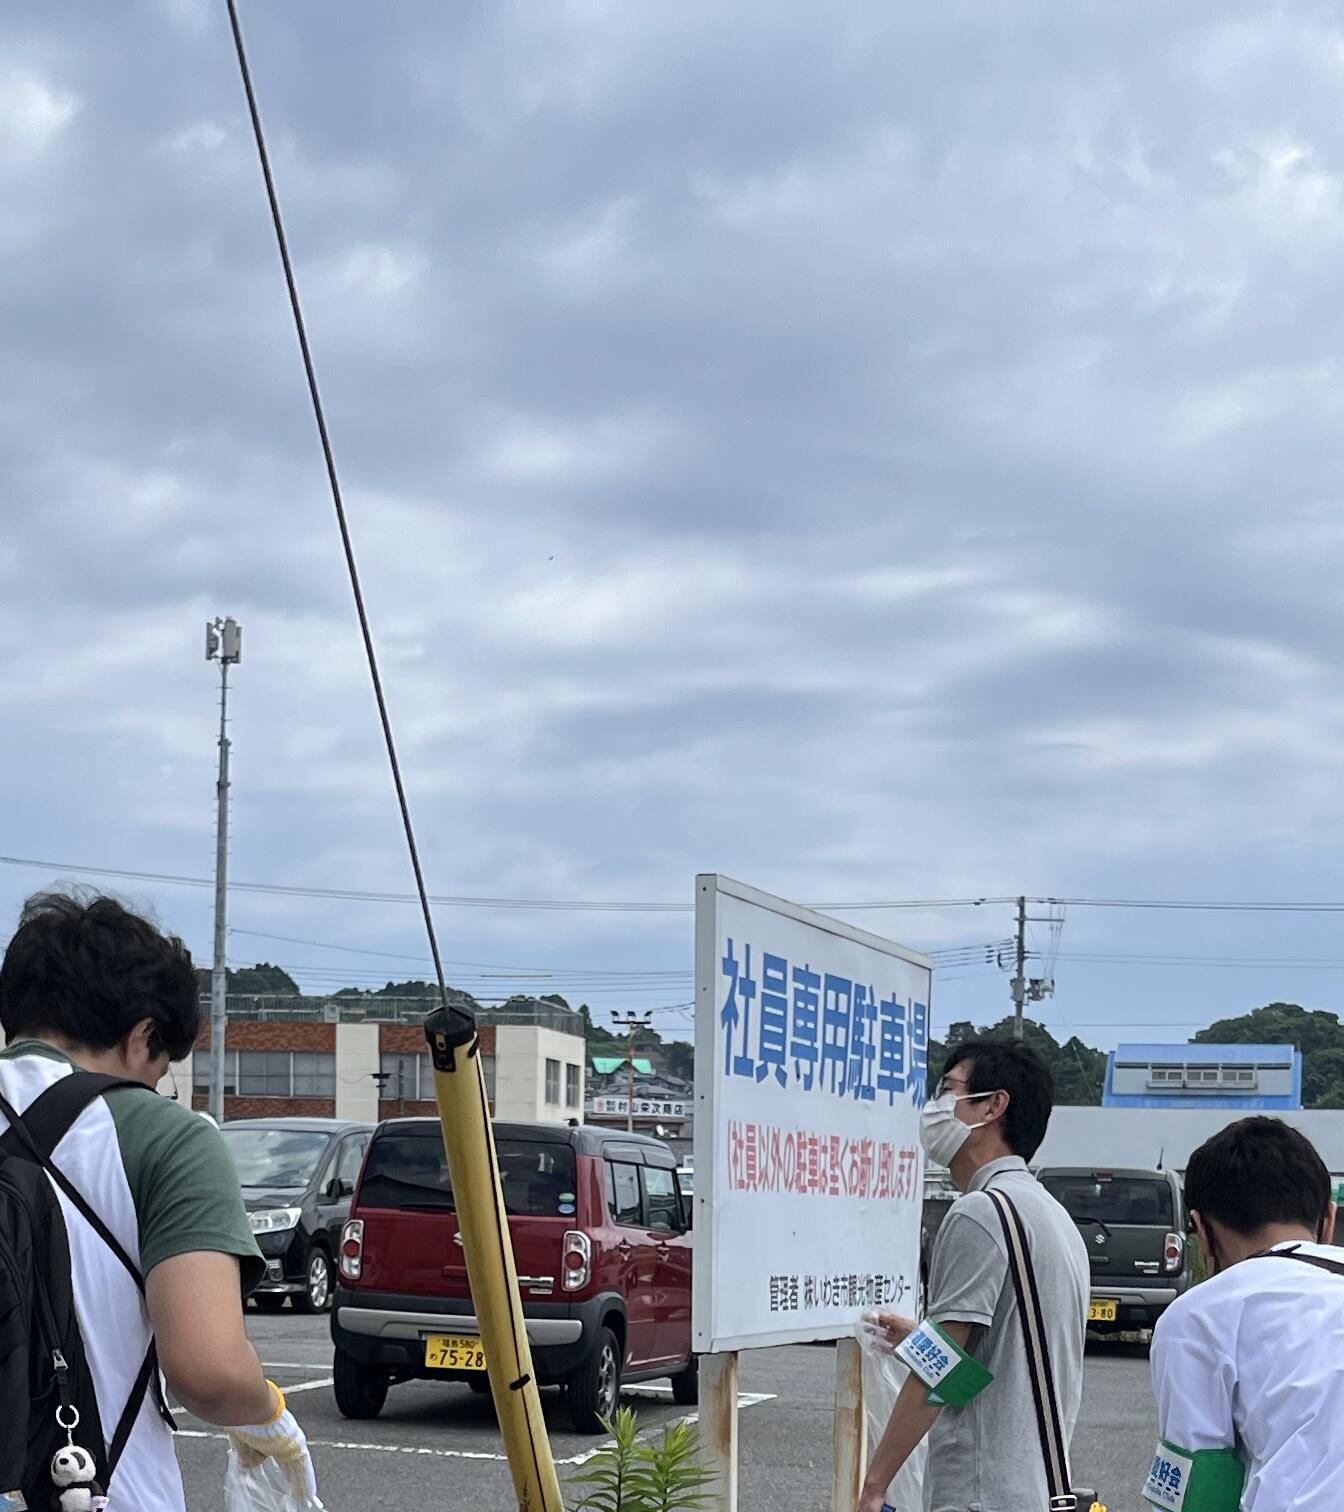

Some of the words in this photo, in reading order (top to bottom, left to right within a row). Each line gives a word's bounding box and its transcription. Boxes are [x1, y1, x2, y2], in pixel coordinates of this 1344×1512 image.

[721, 937, 926, 1111] 社員専用駐車場
[770, 1275, 799, 1312] 管理者
[439, 1349, 484, 1368] 75-28
